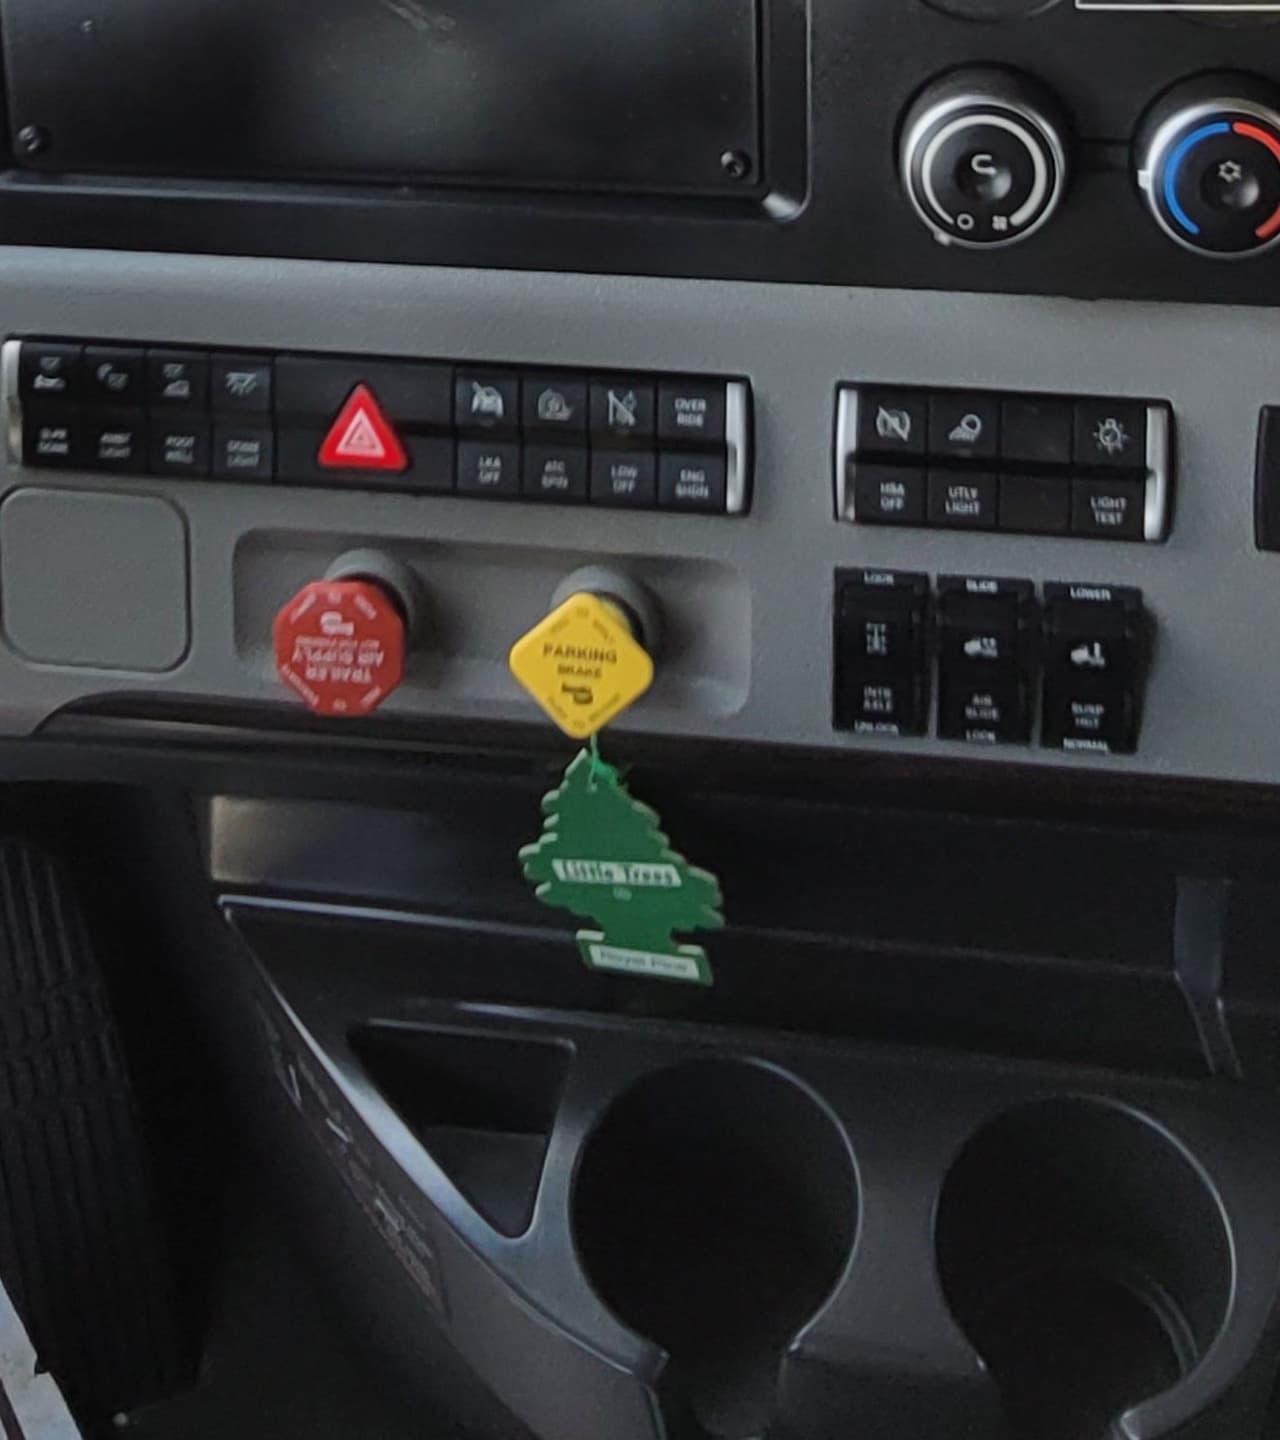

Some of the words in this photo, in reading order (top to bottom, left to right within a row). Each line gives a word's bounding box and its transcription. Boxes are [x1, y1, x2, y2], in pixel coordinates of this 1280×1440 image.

[674, 397, 707, 413] OVER
[676, 412, 705, 428] RIDE
[477, 456, 503, 470] LKA
[477, 469, 501, 484] OFF
[679, 468, 706, 483] ENG
[612, 479, 637, 494] OFF
[880, 496, 904, 511] OFF
[945, 500, 982, 516] LIGHT
[1090, 495, 1128, 511] LIGHT
[1094, 510, 1125, 526] TEST
[1069, 586, 1111, 601] LOWER
[542, 642, 618, 665] PARKING
[556, 663, 603, 680] BRAKE
